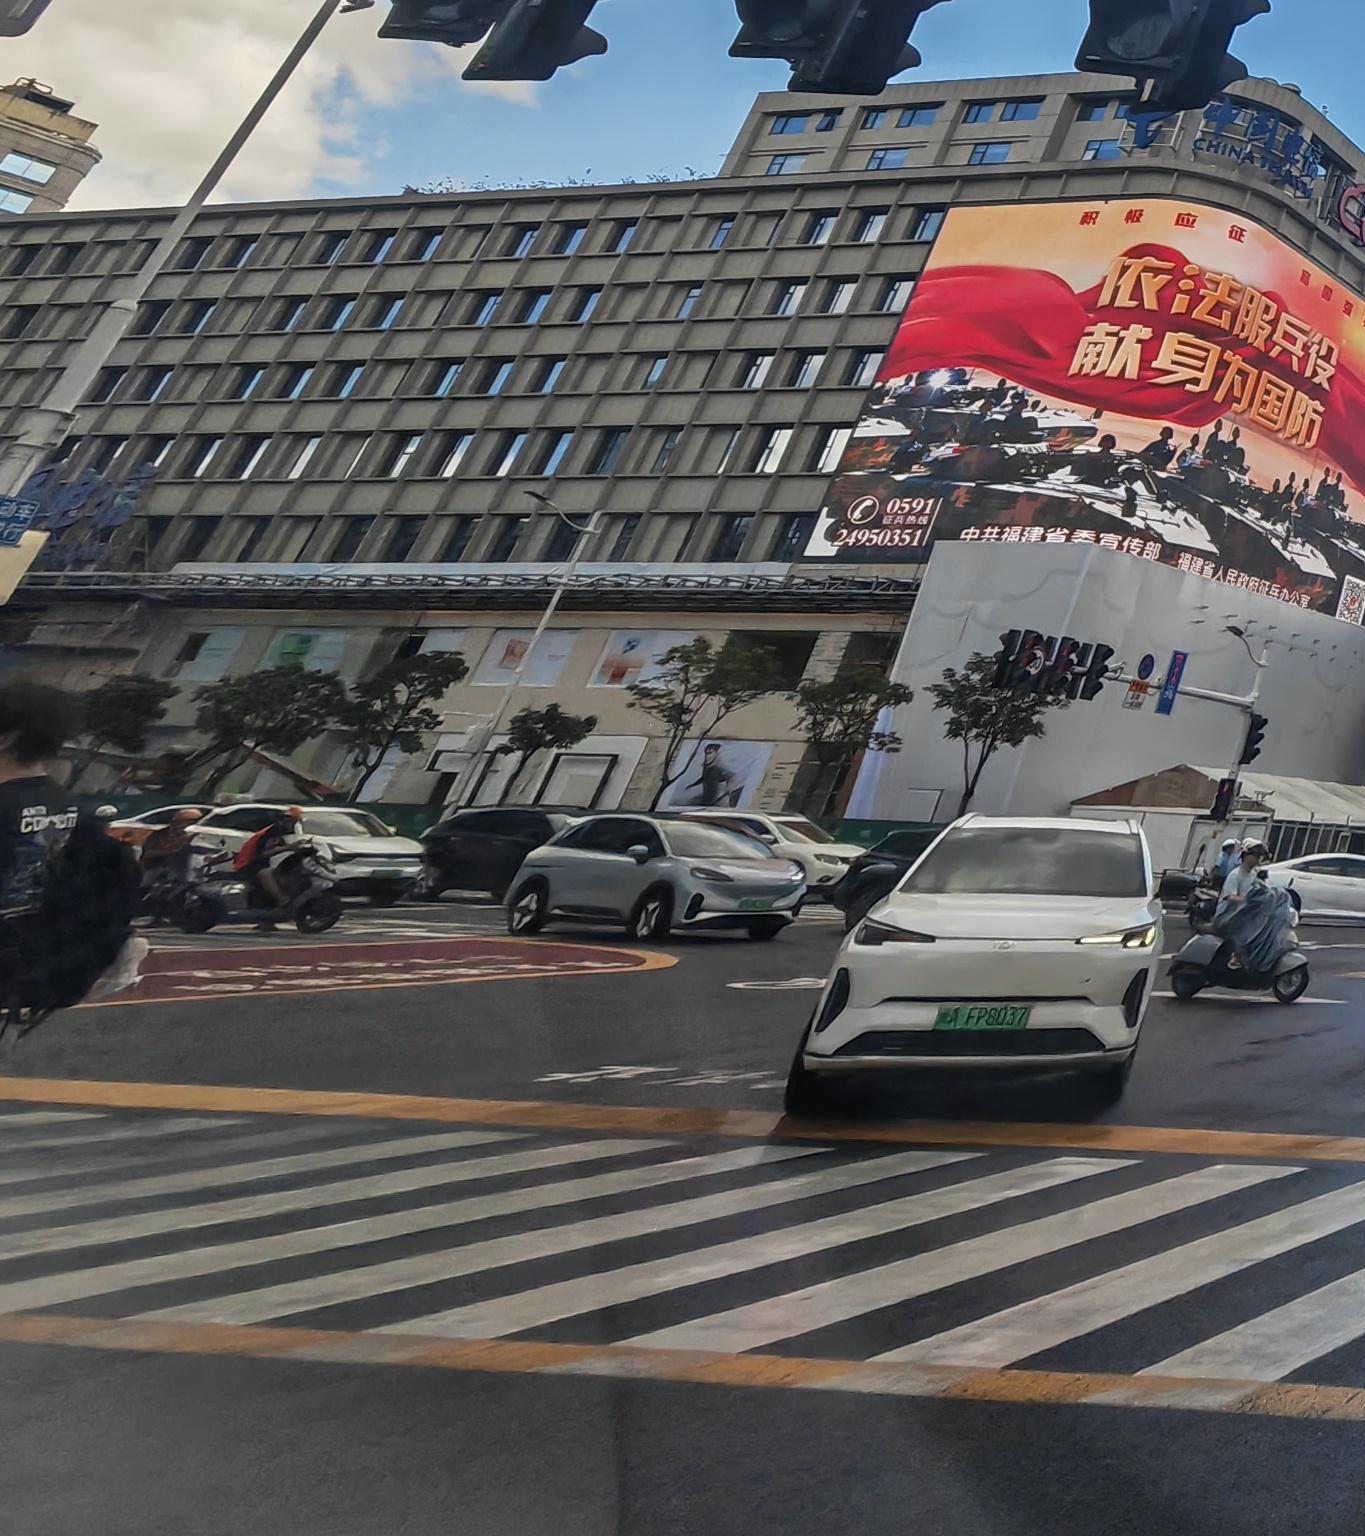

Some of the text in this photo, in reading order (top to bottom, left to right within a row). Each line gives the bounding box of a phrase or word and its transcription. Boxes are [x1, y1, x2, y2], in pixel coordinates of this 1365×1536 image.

[1193, 137, 1255, 165] CHINA
[1078, 208, 1249, 245] 积极应征
[1096, 256, 1341, 392] 依法服兵役
[1067, 321, 1326, 449] 献身为国防
[885, 497, 934, 514] 0591
[831, 528, 923, 547] 24950351
